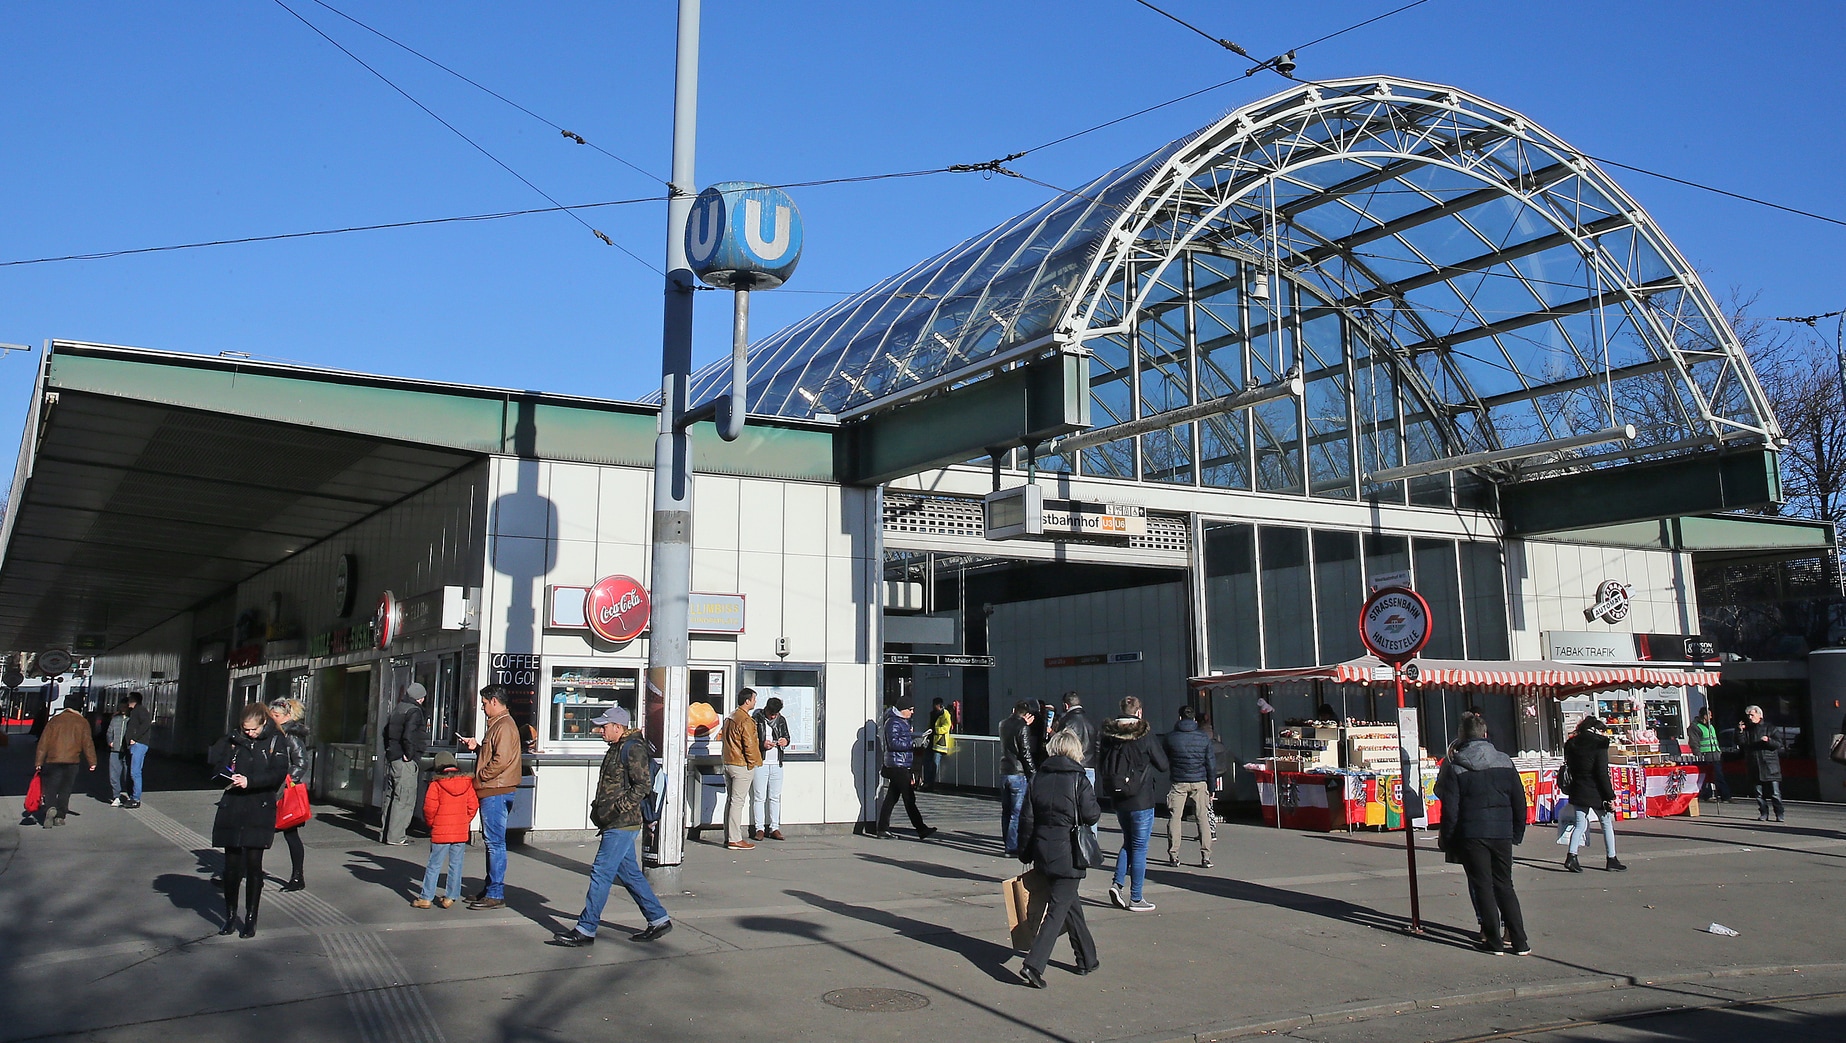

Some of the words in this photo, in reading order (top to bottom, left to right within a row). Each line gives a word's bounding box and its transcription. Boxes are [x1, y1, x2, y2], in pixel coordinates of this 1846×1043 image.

[690, 199, 719, 262] U
[744, 198, 791, 261] U
[1042, 514, 1100, 528] stbahnhof
[1103, 519, 1113, 528] U3
[1115, 520, 1126, 529] U6
[690, 602, 740, 615] LLIMBISS
[1369, 597, 1421, 622] STRASSENBAHN
[1594, 595, 1622, 617] AUTOMAT
[1372, 629, 1420, 651] HALTESTELLE
[1555, 646, 1585, 657] TABAK
[1585, 647, 1616, 658] TRAFIK
[492, 654, 540, 670] COFFEE
[496, 670, 513, 685] TO
[514, 670, 536, 686] GO!
[1407, 667, 1418, 678] 52
